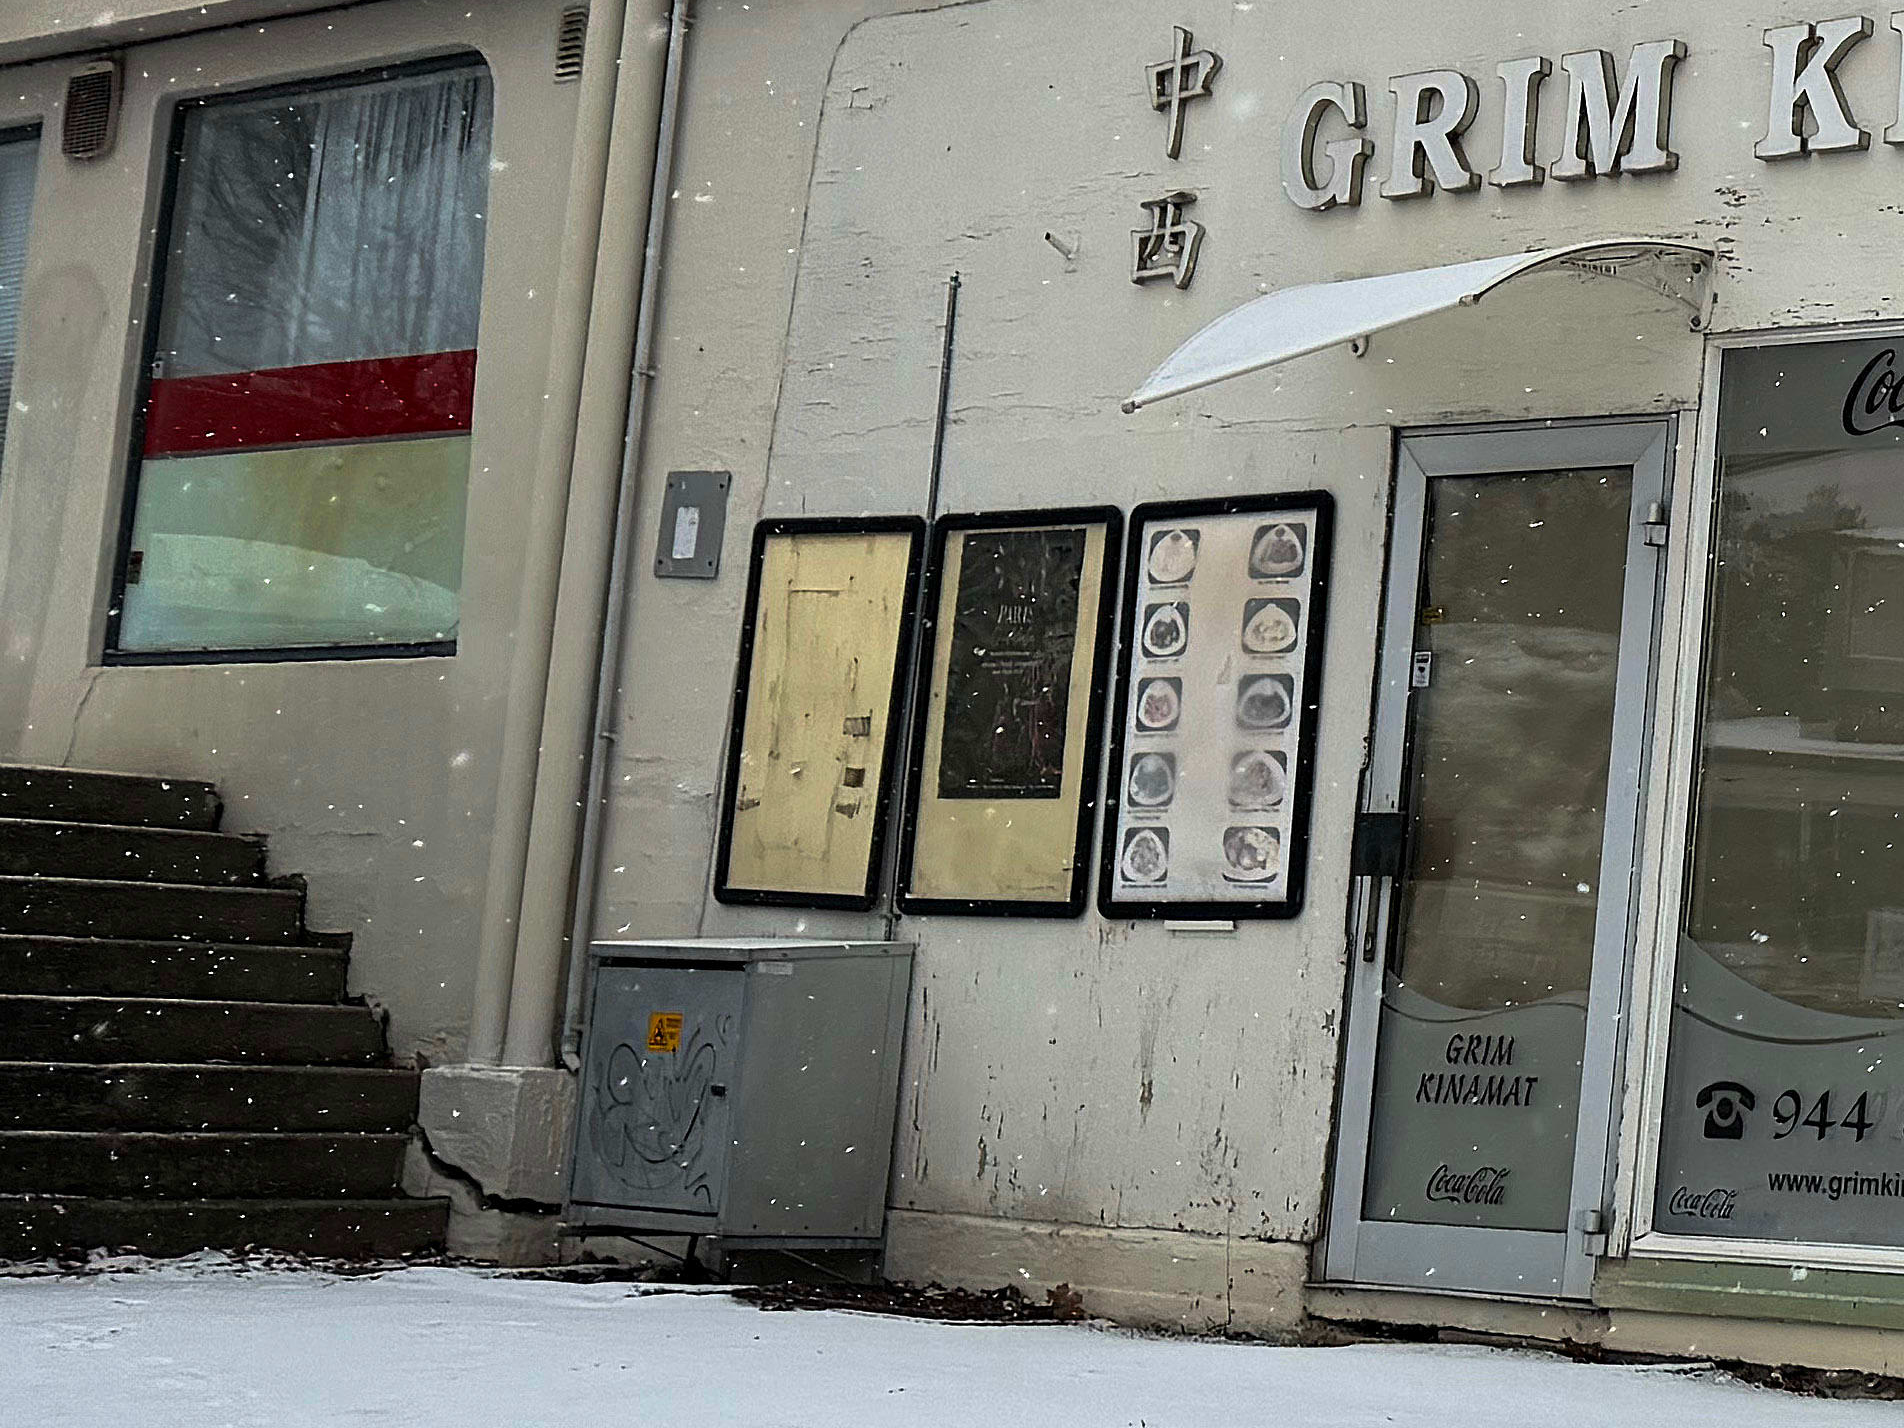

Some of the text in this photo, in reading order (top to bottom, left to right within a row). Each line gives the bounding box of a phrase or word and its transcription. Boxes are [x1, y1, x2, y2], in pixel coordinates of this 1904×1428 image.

[1280, 38, 1688, 212] GRIM
[1130, 25, 1224, 291] 中西
[1445, 1032, 1516, 1066] GRIM
[1415, 1072, 1539, 1107] KINAMAT
[1771, 1088, 1874, 1143] 944
[1426, 1163, 1512, 1205] Coca-Cola
[1668, 1185, 1739, 1220] Coca-Cola
